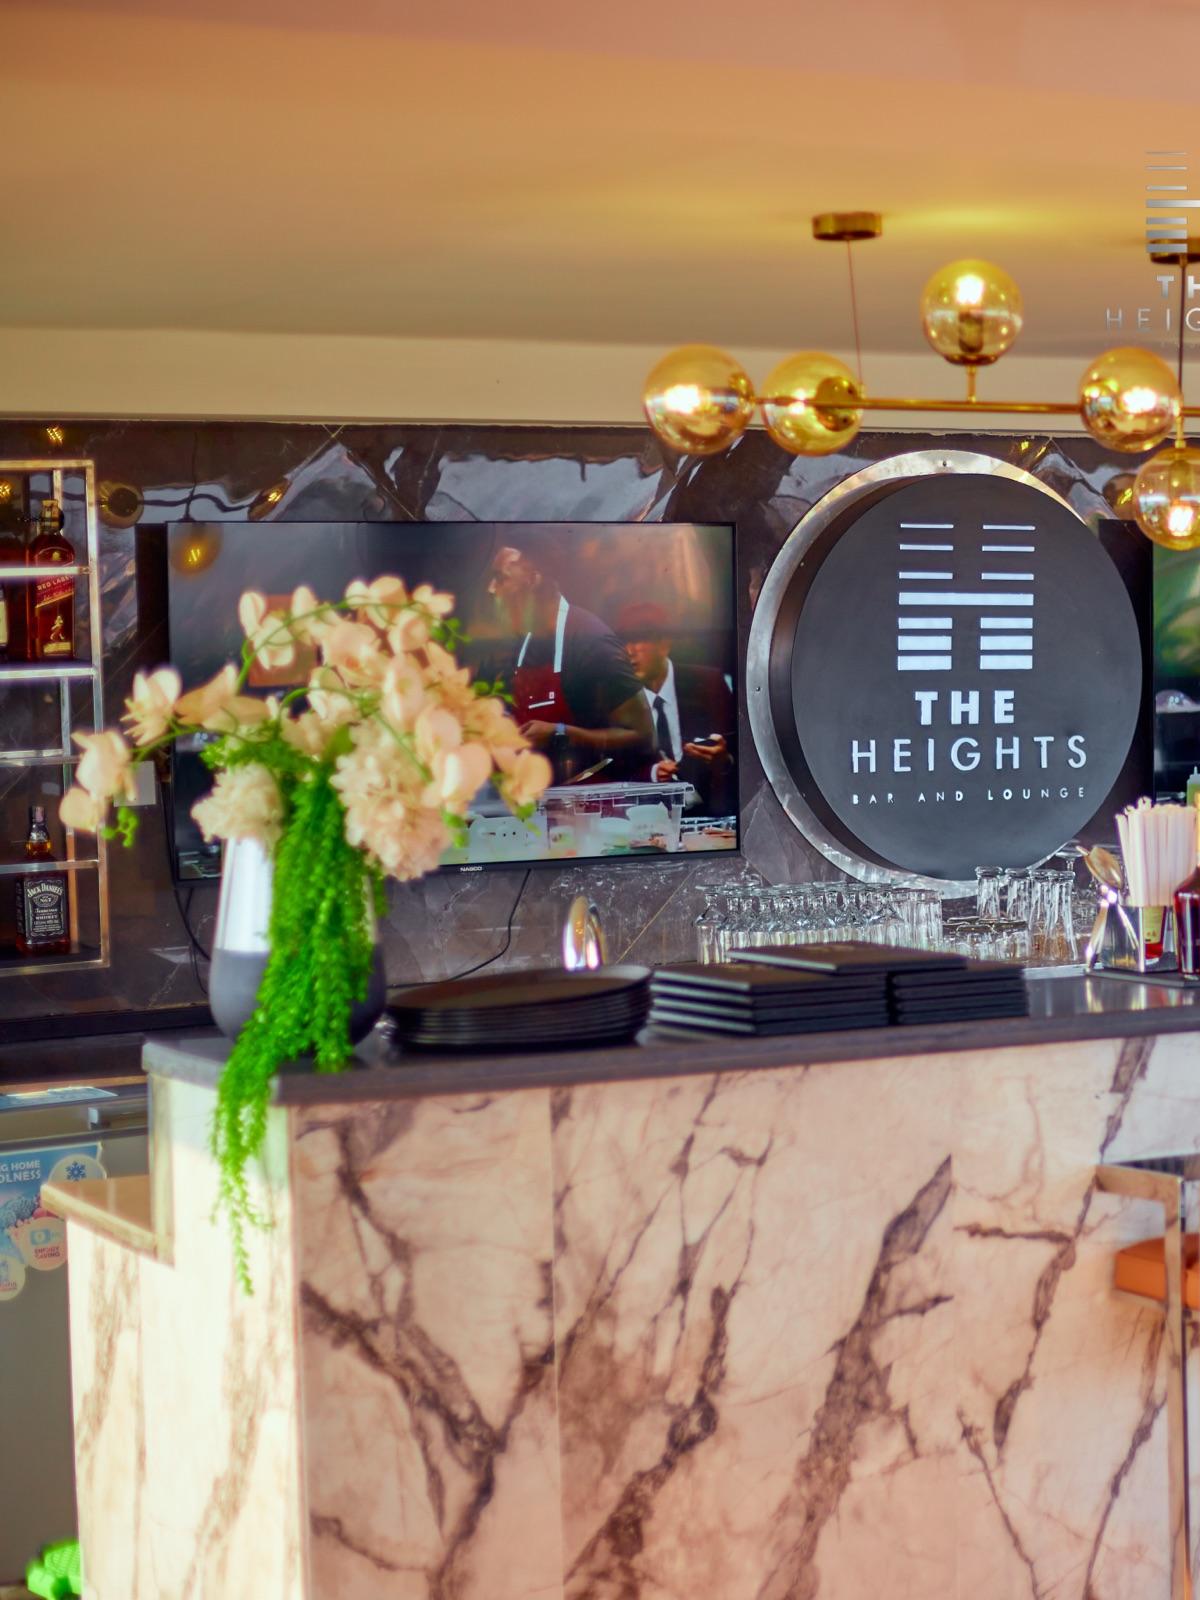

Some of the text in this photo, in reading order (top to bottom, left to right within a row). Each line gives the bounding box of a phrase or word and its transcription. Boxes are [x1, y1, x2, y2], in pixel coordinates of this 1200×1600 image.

[914, 690, 1015, 725] THE
[852, 735, 1087, 773] HEIGHTS
[852, 787, 1084, 804] BAR AND LOUNGE
[11, 1160, 40, 1171] HOME
